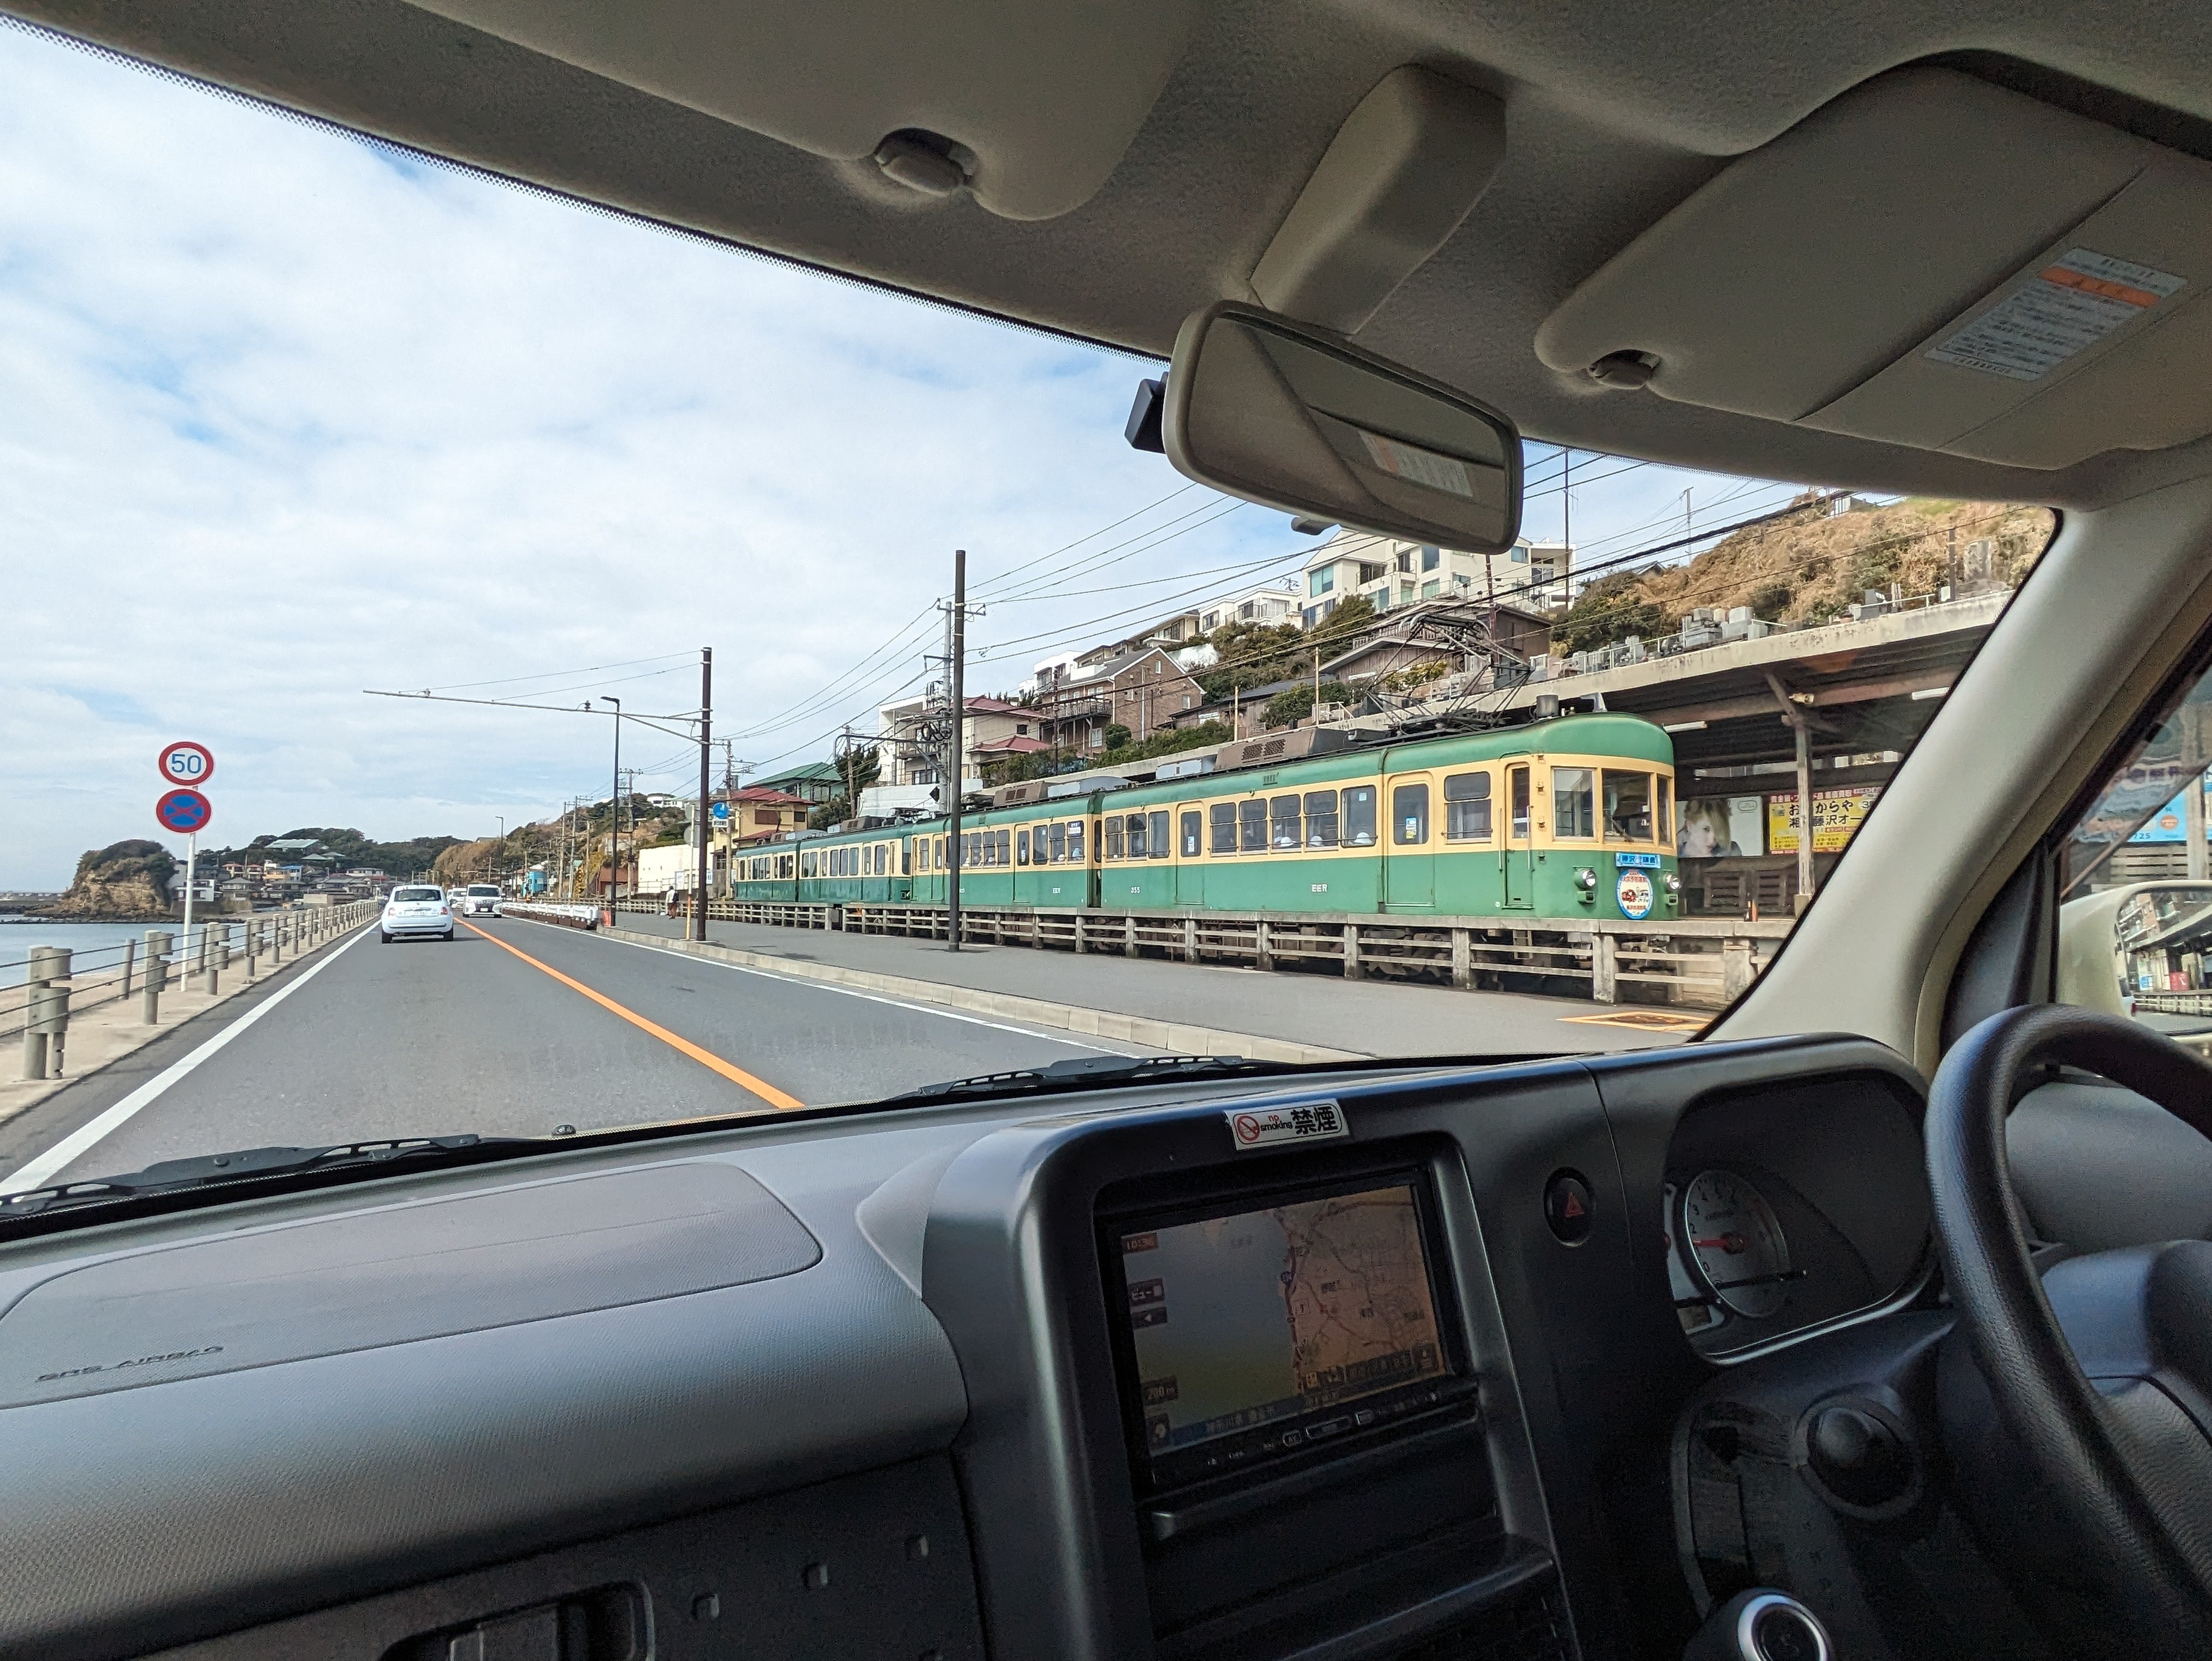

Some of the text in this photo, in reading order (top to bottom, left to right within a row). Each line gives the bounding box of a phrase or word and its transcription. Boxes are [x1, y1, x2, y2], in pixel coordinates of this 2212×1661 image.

[171, 753, 201, 774] 50
[1789, 800, 1854, 816] おからや
[1311, 884, 1327, 892] EER
[1260, 1121, 1293, 1131] smoking
[1290, 1107, 1338, 1134] 禁煙
